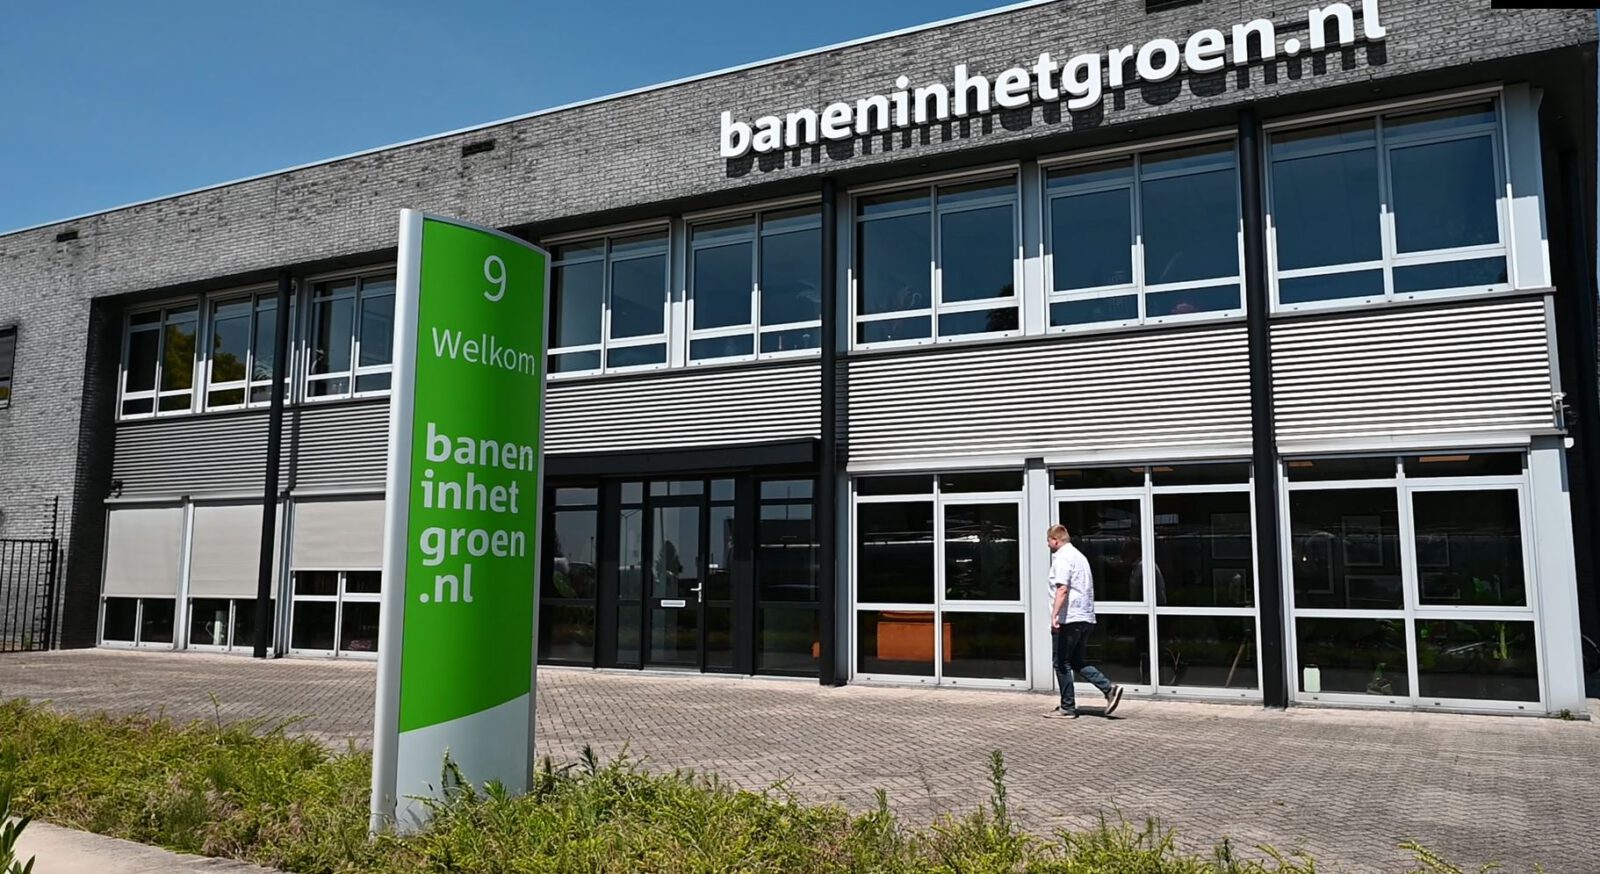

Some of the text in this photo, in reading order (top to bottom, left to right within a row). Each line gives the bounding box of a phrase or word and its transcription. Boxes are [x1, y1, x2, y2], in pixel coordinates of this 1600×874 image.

[719, 0, 1387, 160] baneninhetgroen.nl
[482, 254, 508, 303] 9
[431, 326, 536, 376] Welkom
[425, 422, 534, 472] banen
[421, 468, 520, 514] inhet
[419, 525, 526, 567] groen
[419, 563, 474, 604] .nl
